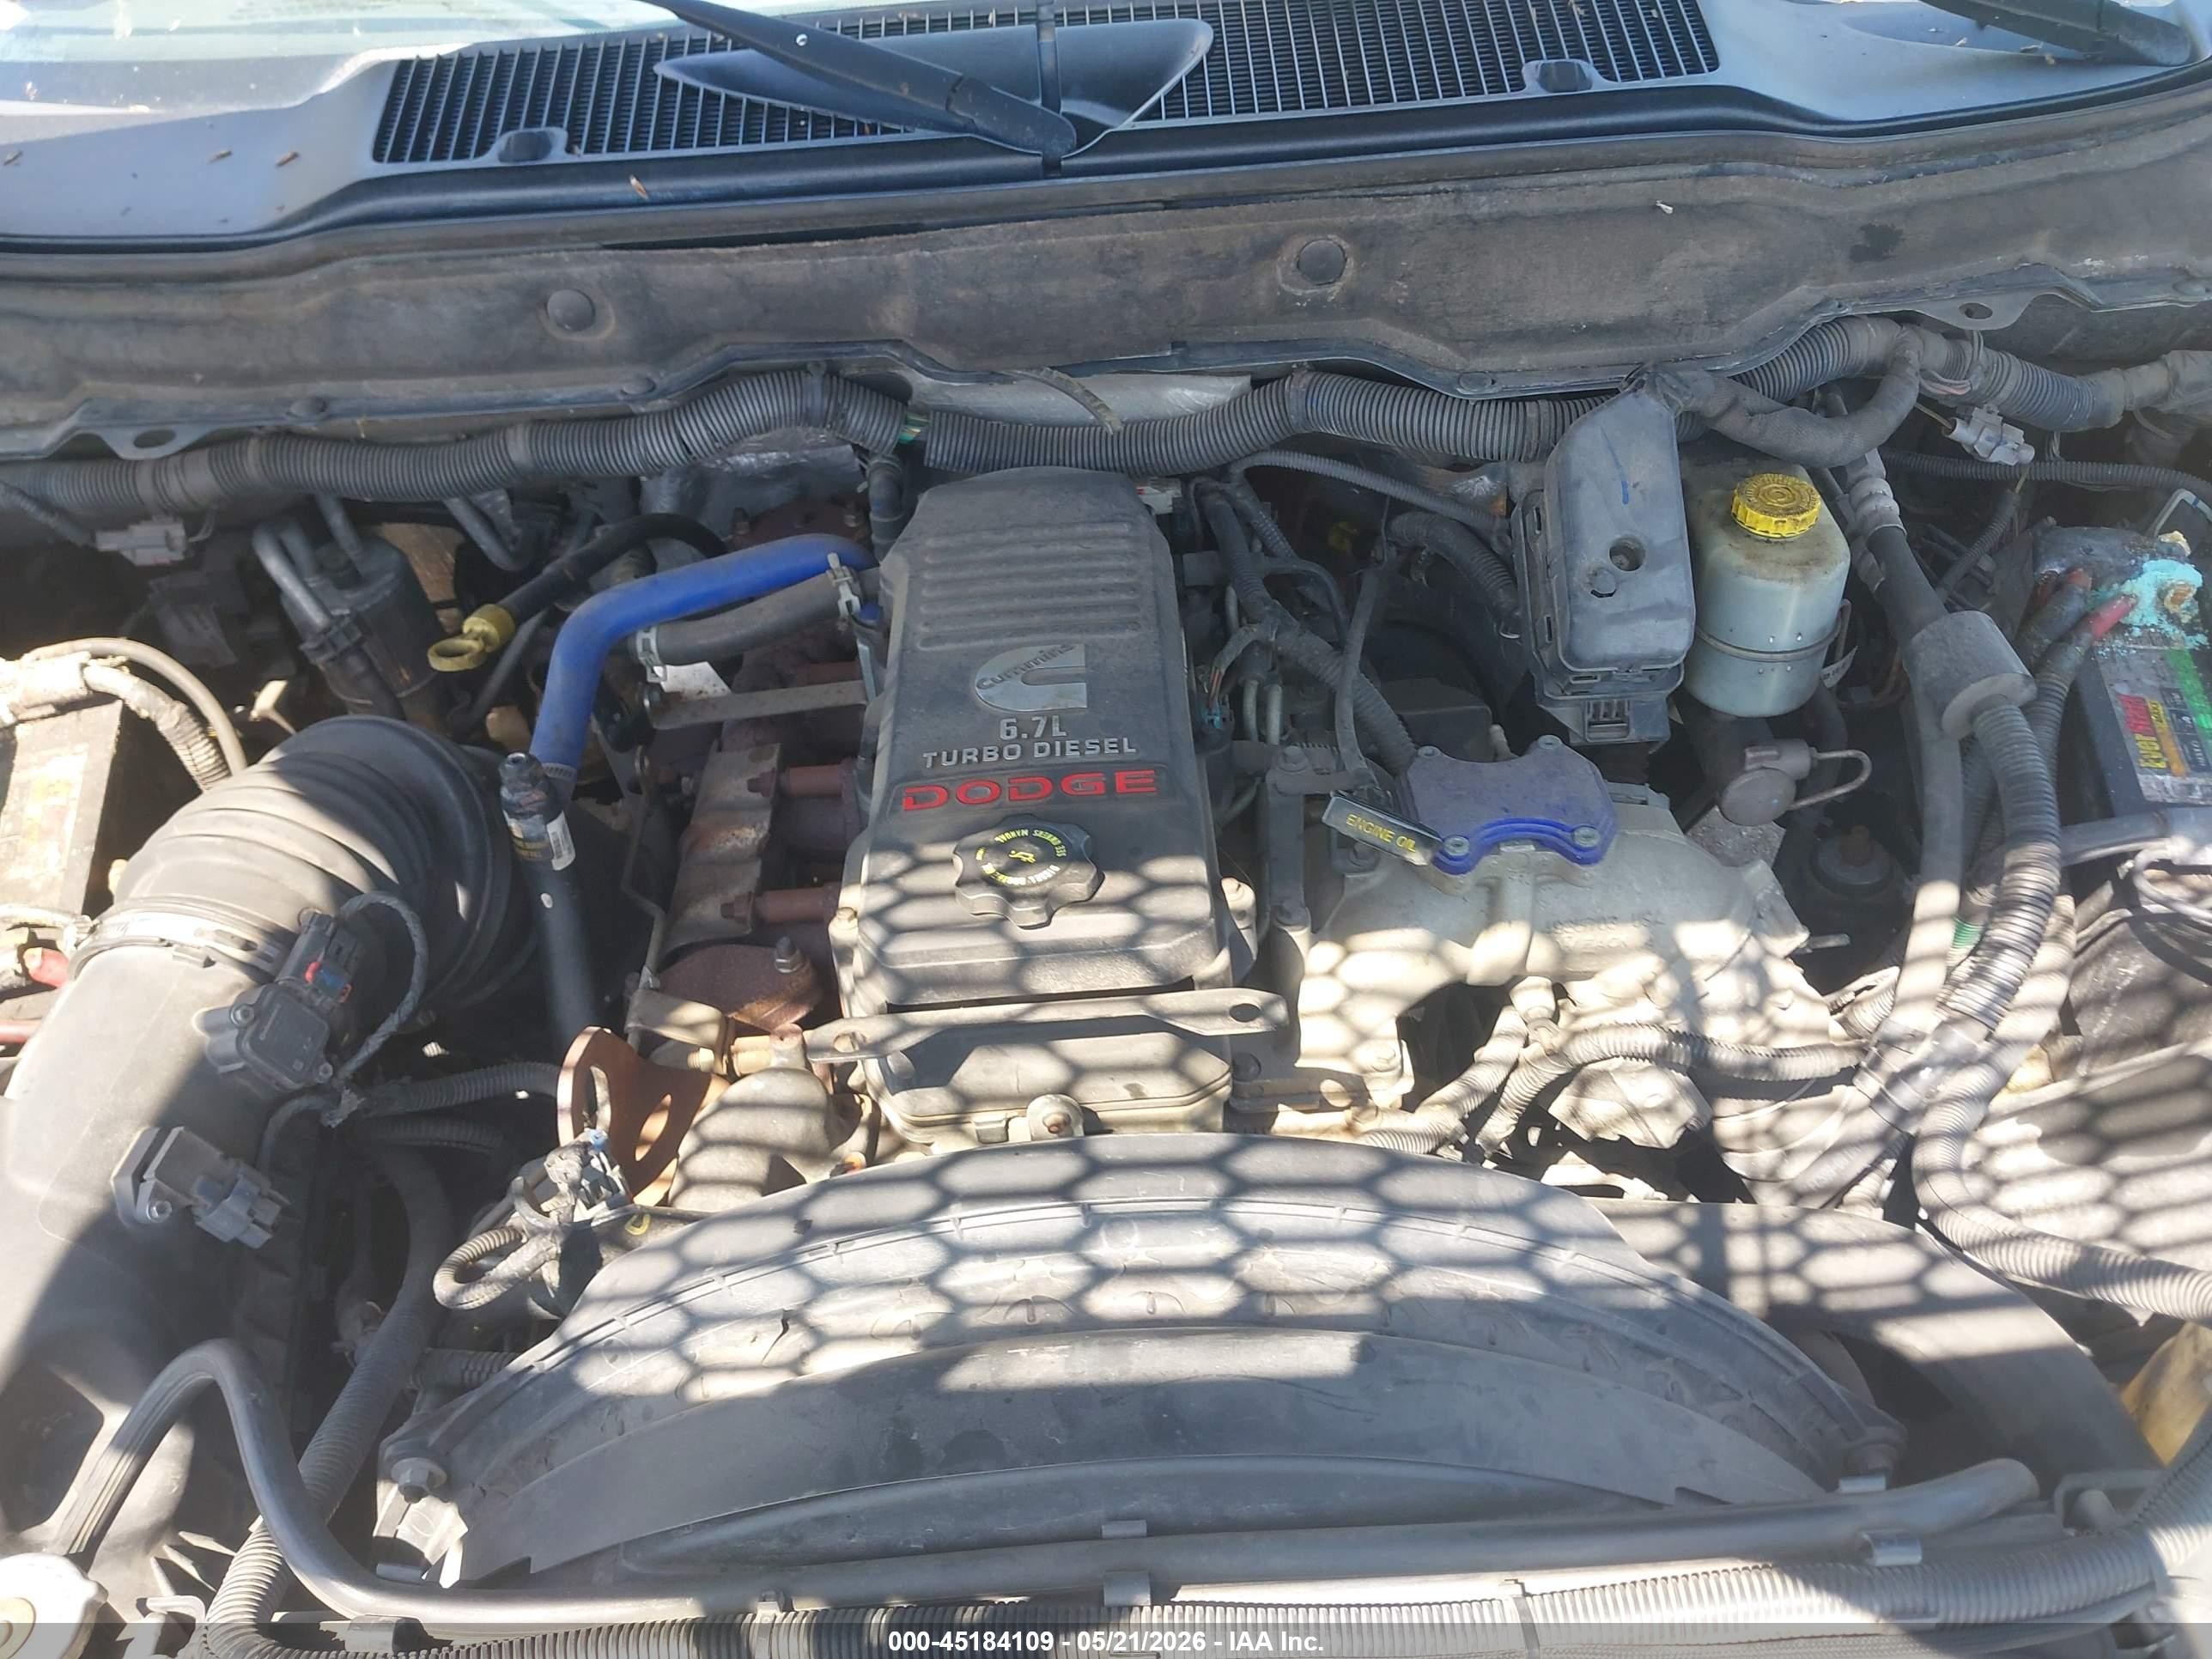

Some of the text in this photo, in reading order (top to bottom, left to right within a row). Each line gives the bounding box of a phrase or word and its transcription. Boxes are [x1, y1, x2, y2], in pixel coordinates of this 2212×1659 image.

[976, 643, 1076, 690] Cummins
[1000, 715, 1067, 740] 6.7L
[922, 737, 1137, 769] TURBO DIESEL
[902, 769, 1157, 811] DODGE
[1346, 813, 1417, 853] ENGINE OIL
